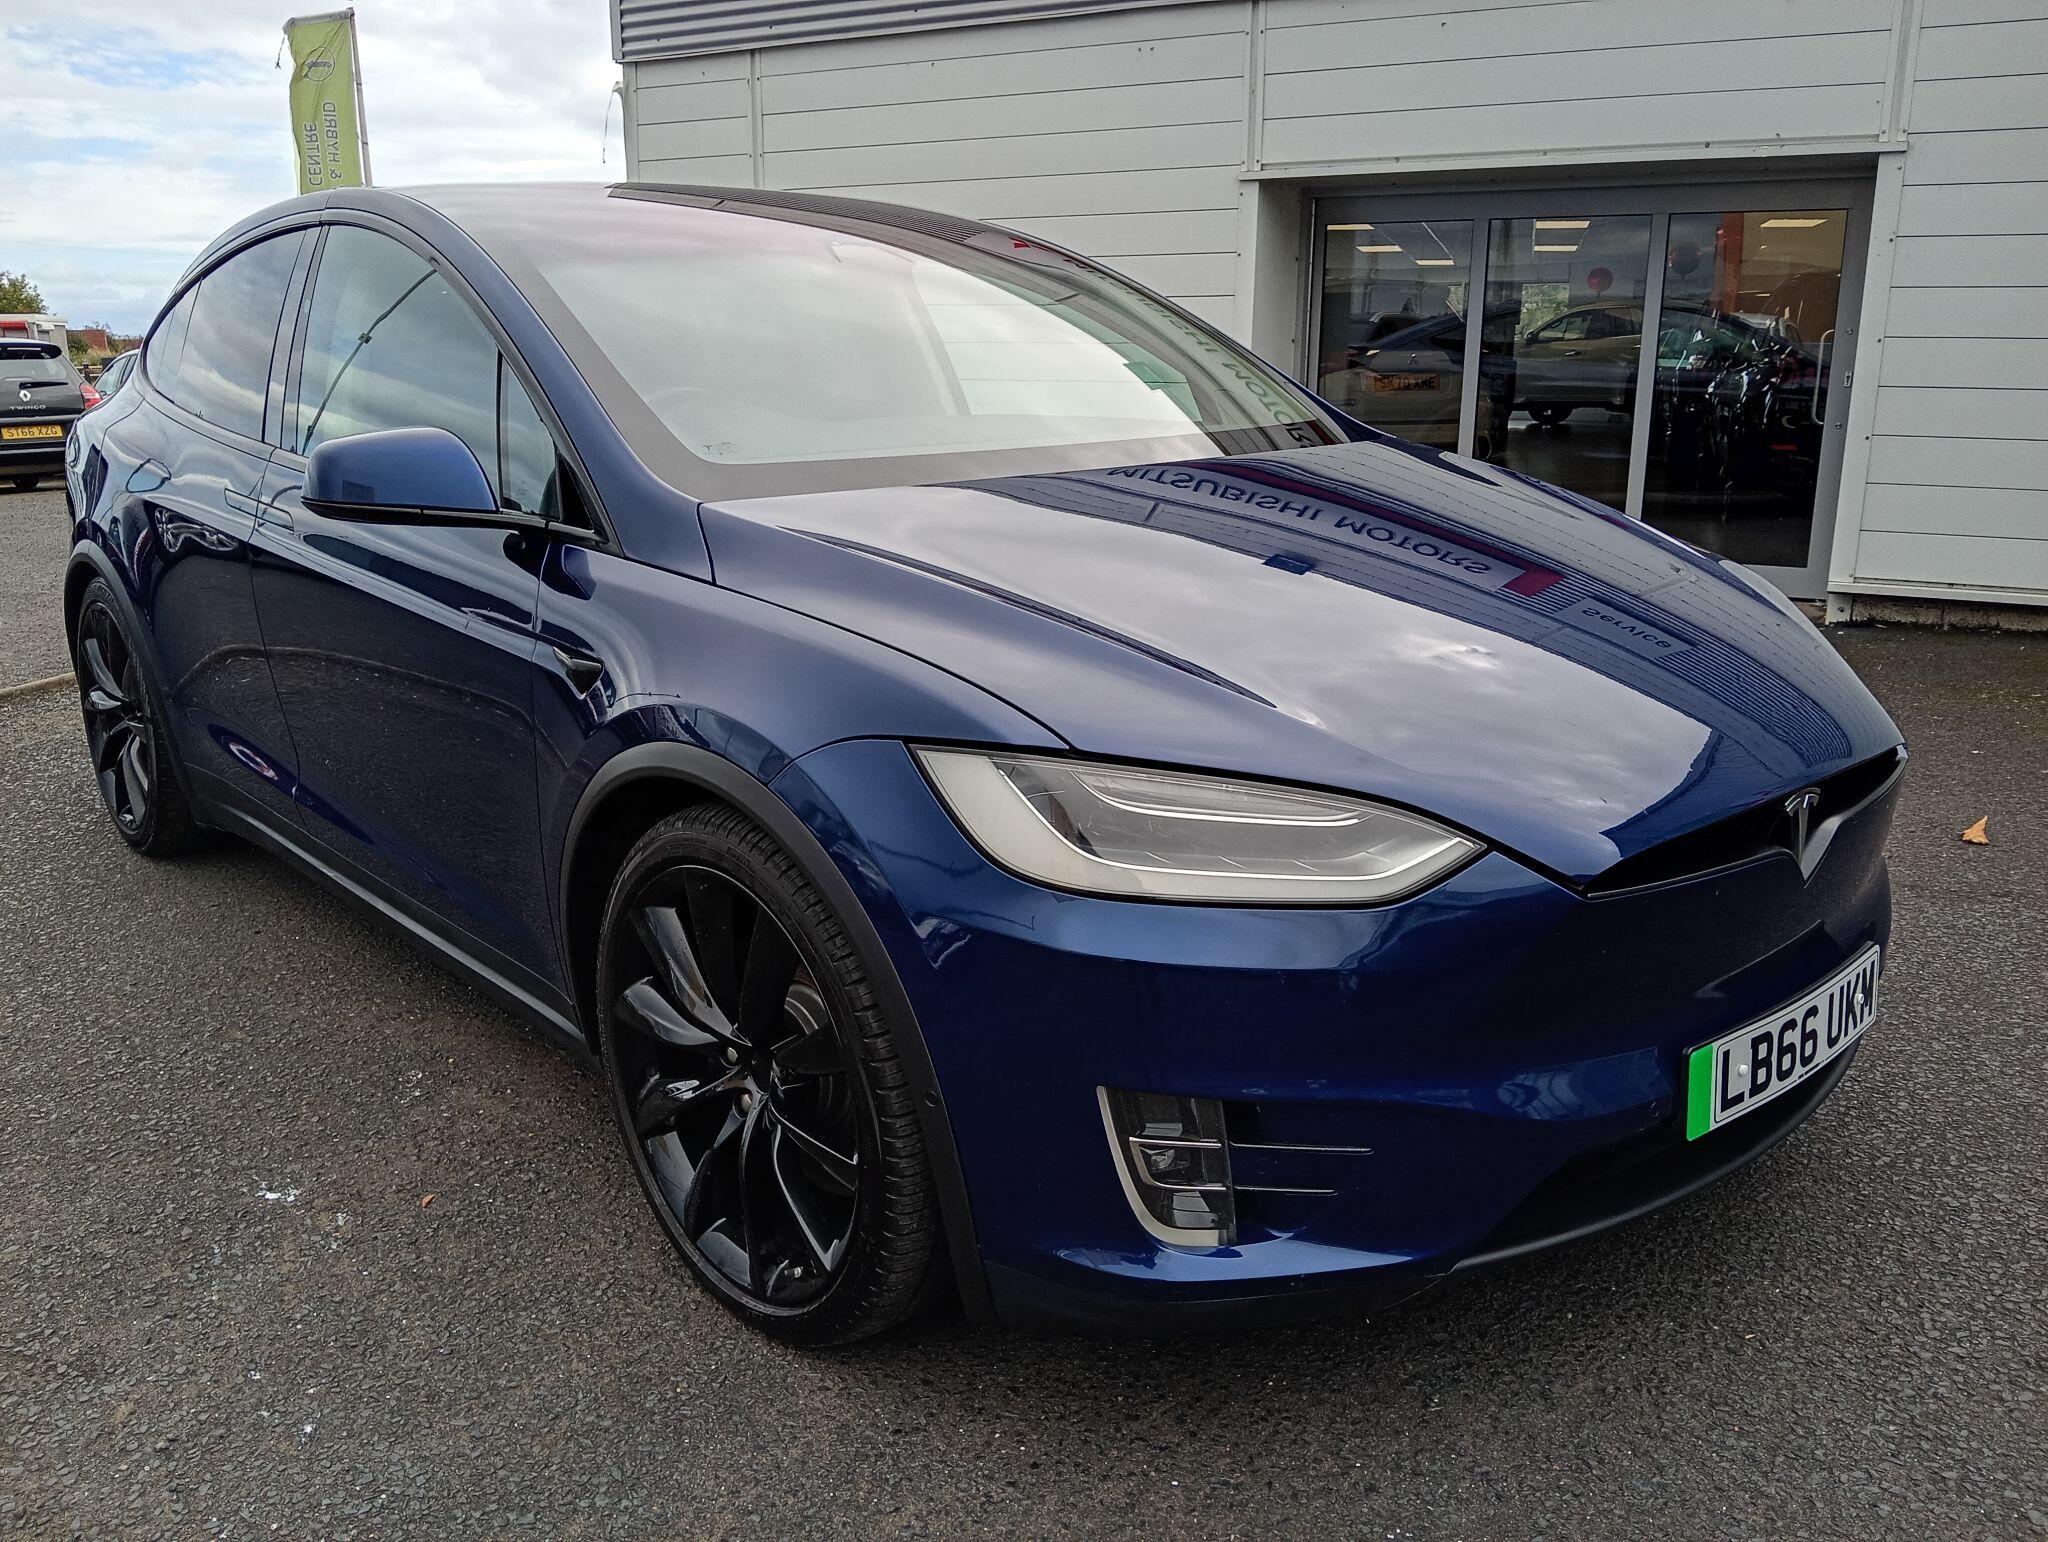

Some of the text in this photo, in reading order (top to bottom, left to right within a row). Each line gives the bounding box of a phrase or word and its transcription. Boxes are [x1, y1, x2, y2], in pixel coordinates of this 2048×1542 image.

[7, 424, 57, 438] ST66 XZG
[1720, 960, 1875, 1113] LB66 UKM
